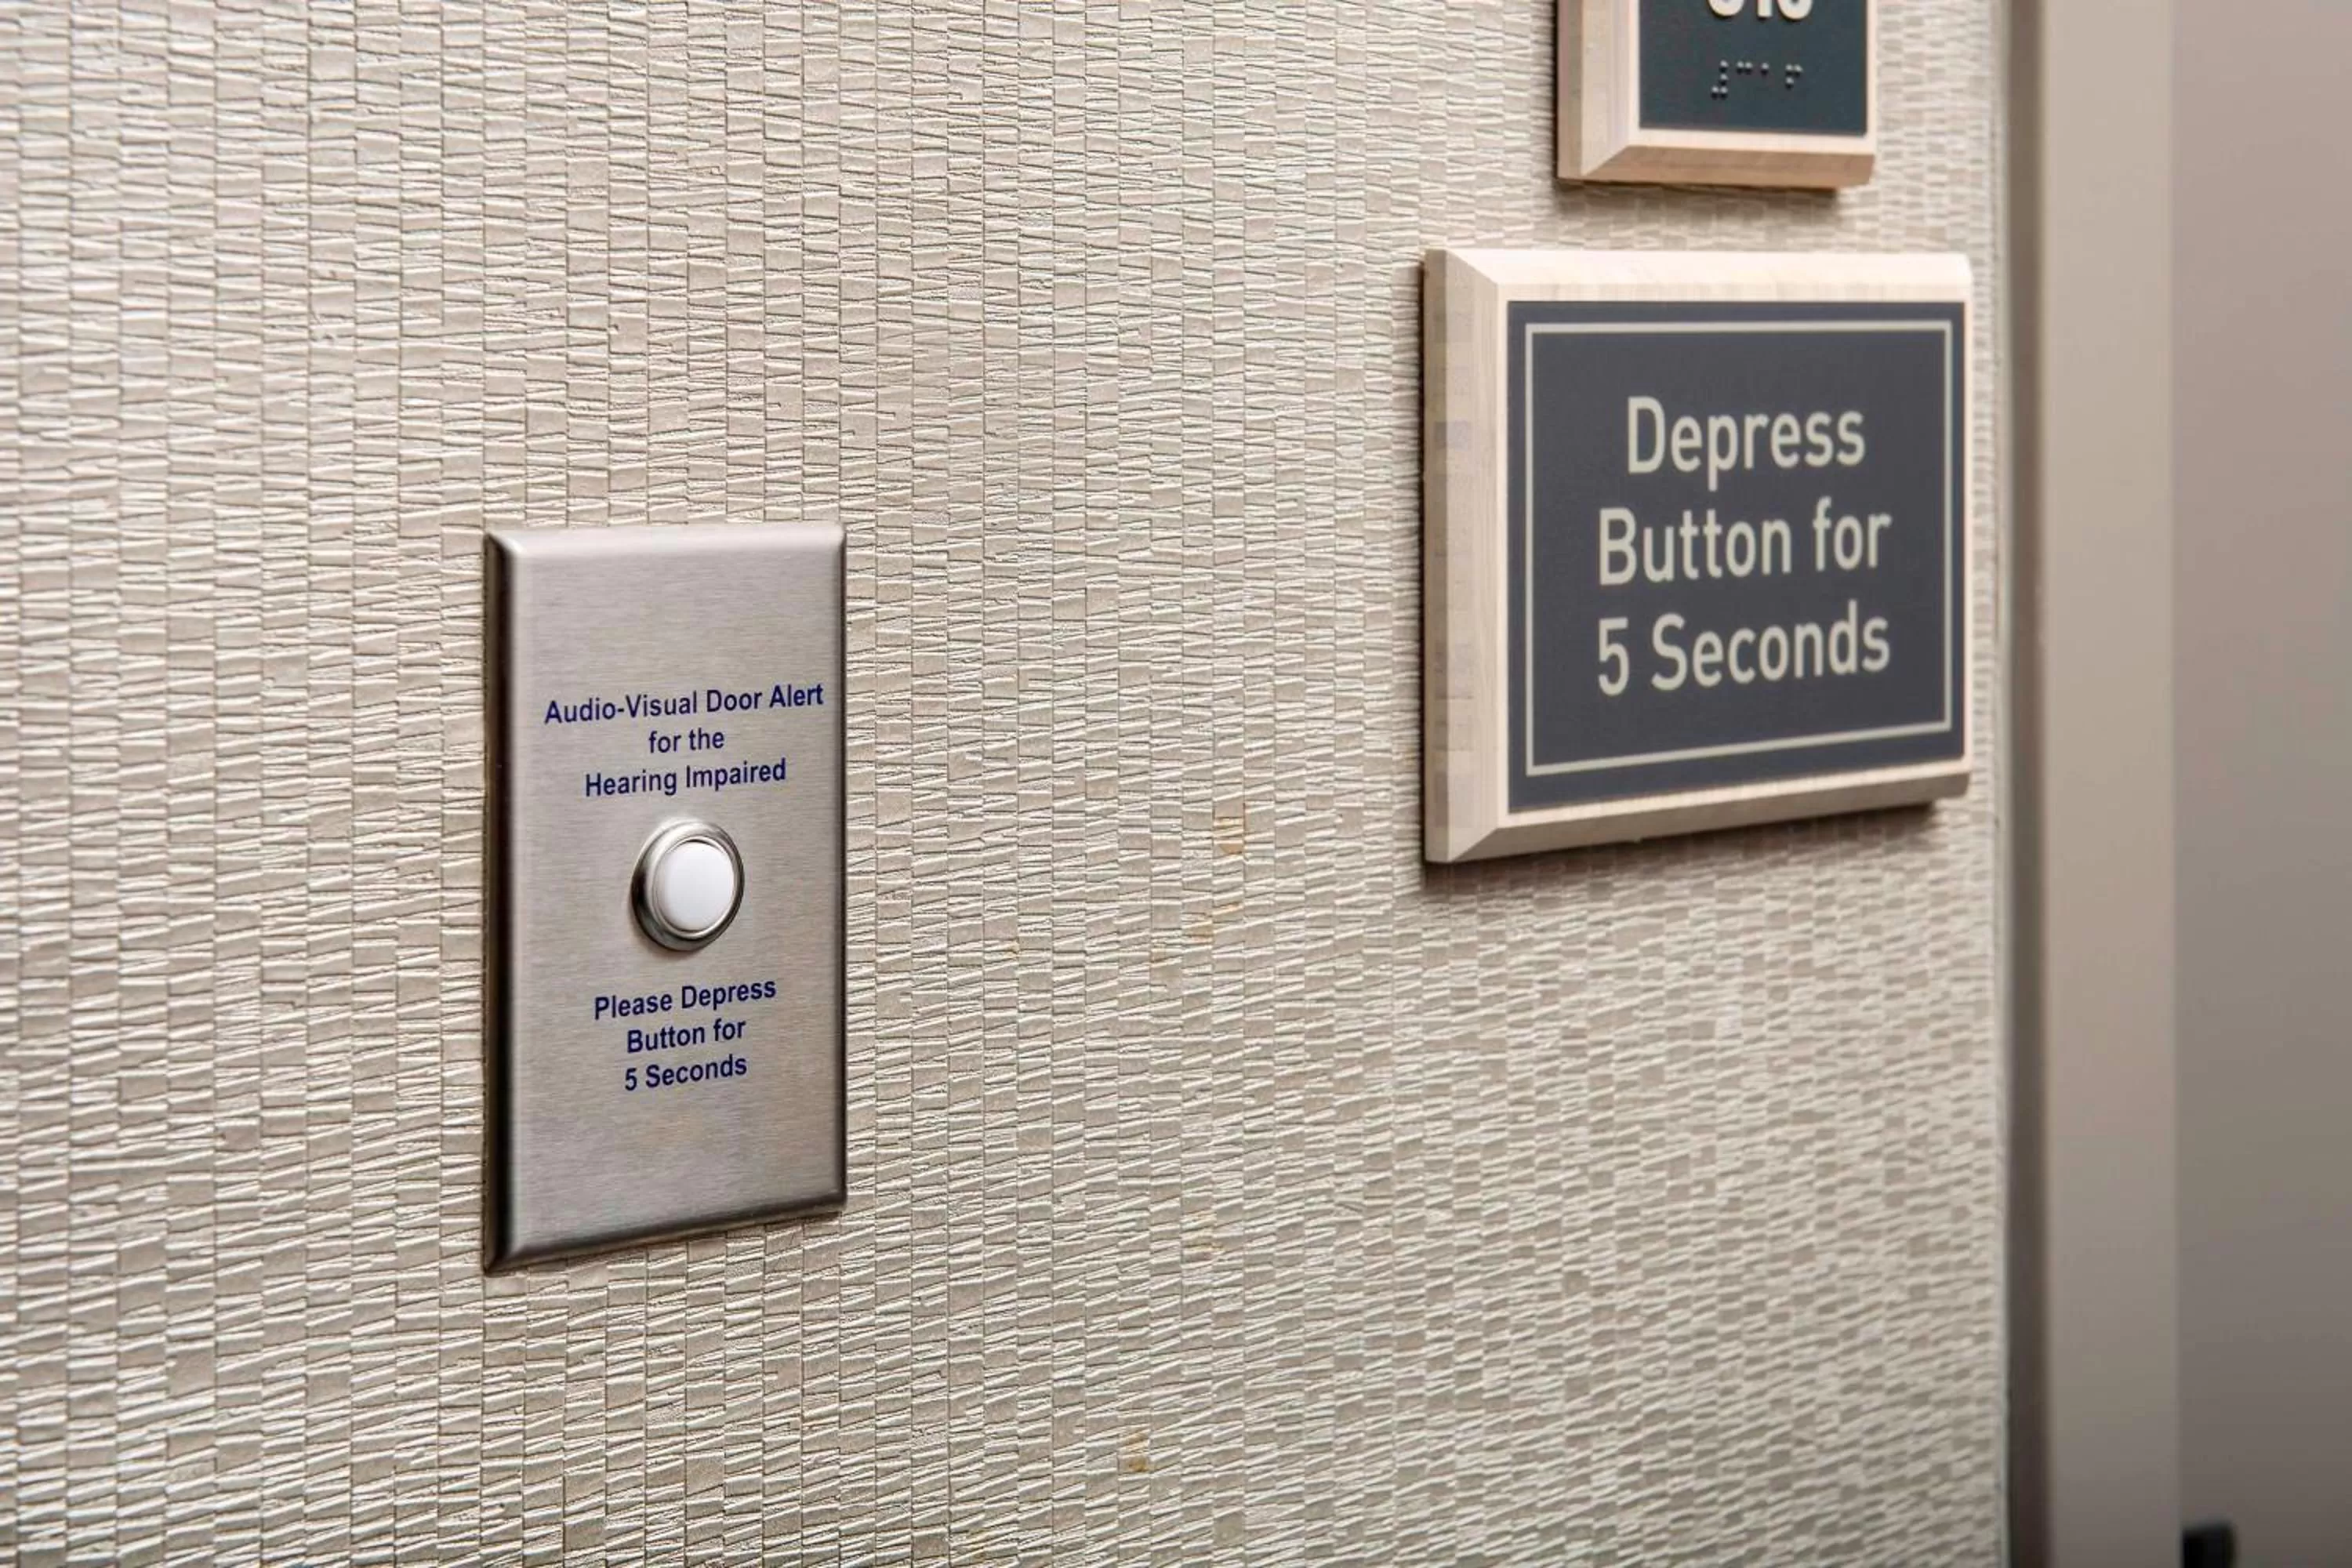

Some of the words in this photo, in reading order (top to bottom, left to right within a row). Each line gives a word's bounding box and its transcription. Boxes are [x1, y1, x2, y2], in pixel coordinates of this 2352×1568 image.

[1628, 396, 1865, 492] Depress
[1599, 507, 1791, 585] Button
[1813, 496, 1892, 571] for
[1599, 617, 1629, 695] 5
[1652, 600, 1890, 690] Seconds
[545, 691, 697, 724] Audio-Visual
[706, 689, 762, 713] Door
[769, 684, 823, 708] Alert
[648, 731, 681, 753] for
[688, 728, 724, 750] the
[586, 769, 677, 797] Hearing
[686, 757, 786, 791] Impaired
[595, 993, 673, 1019] Please
[681, 981, 776, 1011] Depress
[628, 1025, 705, 1053] Button
[713, 1018, 746, 1041] for
[625, 1067, 637, 1091] 5
[645, 1054, 747, 1088] Seconds
